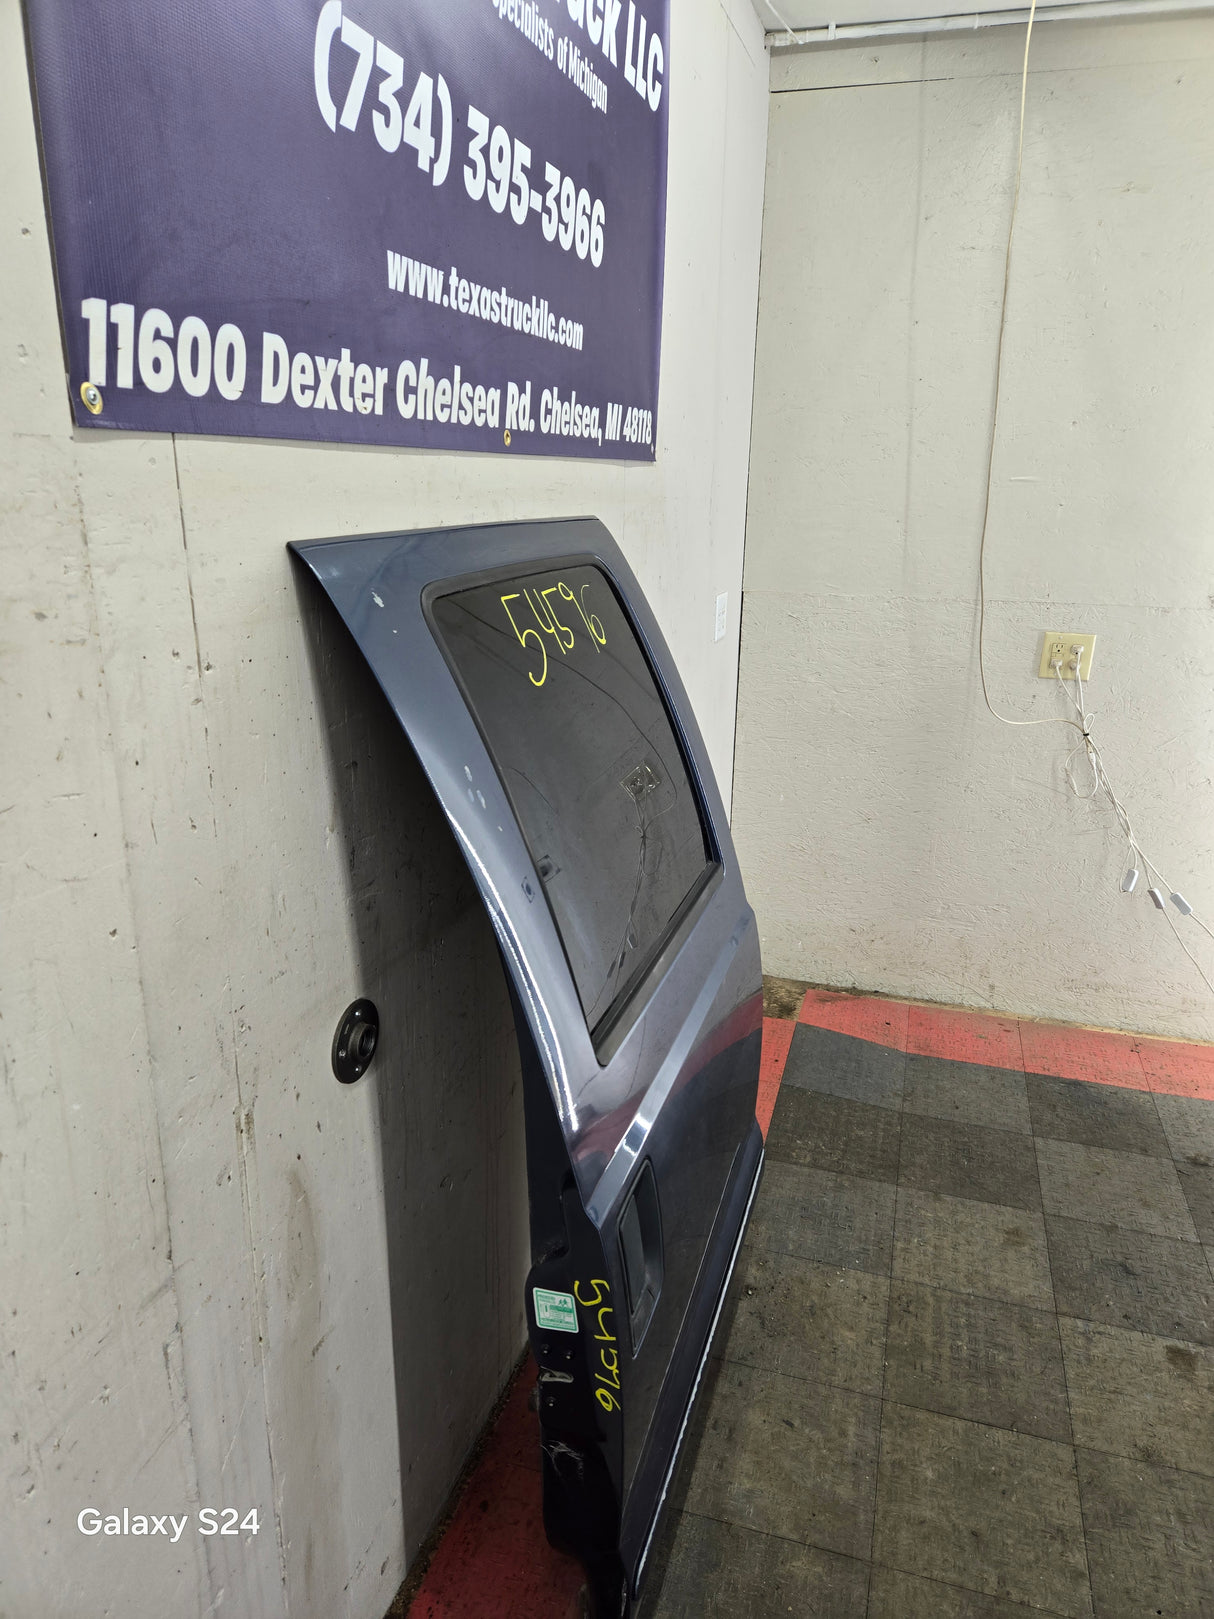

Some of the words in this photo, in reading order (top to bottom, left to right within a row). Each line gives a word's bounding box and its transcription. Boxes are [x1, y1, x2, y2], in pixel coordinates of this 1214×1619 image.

[491, 0, 554, 61] pecialists
[557, 36, 568, 74] of
[568, 41, 608, 114] Michigan
[624, 0, 664, 111] LLC
[314, 0, 453, 186] (734)
[463, 104, 606, 268] 395-3966
[386, 249, 584, 350] www.texastruckllc.com
[81, 297, 247, 401] 11600
[260, 331, 388, 416] Dexter
[396, 357, 501, 429] Chelsea
[505, 380, 536, 432] Rd.
[540, 386, 603, 446] Chelsea,
[605, 402, 623, 441] MI
[623, 406, 653, 444] 48118
[500, 582, 607, 687] 54596
